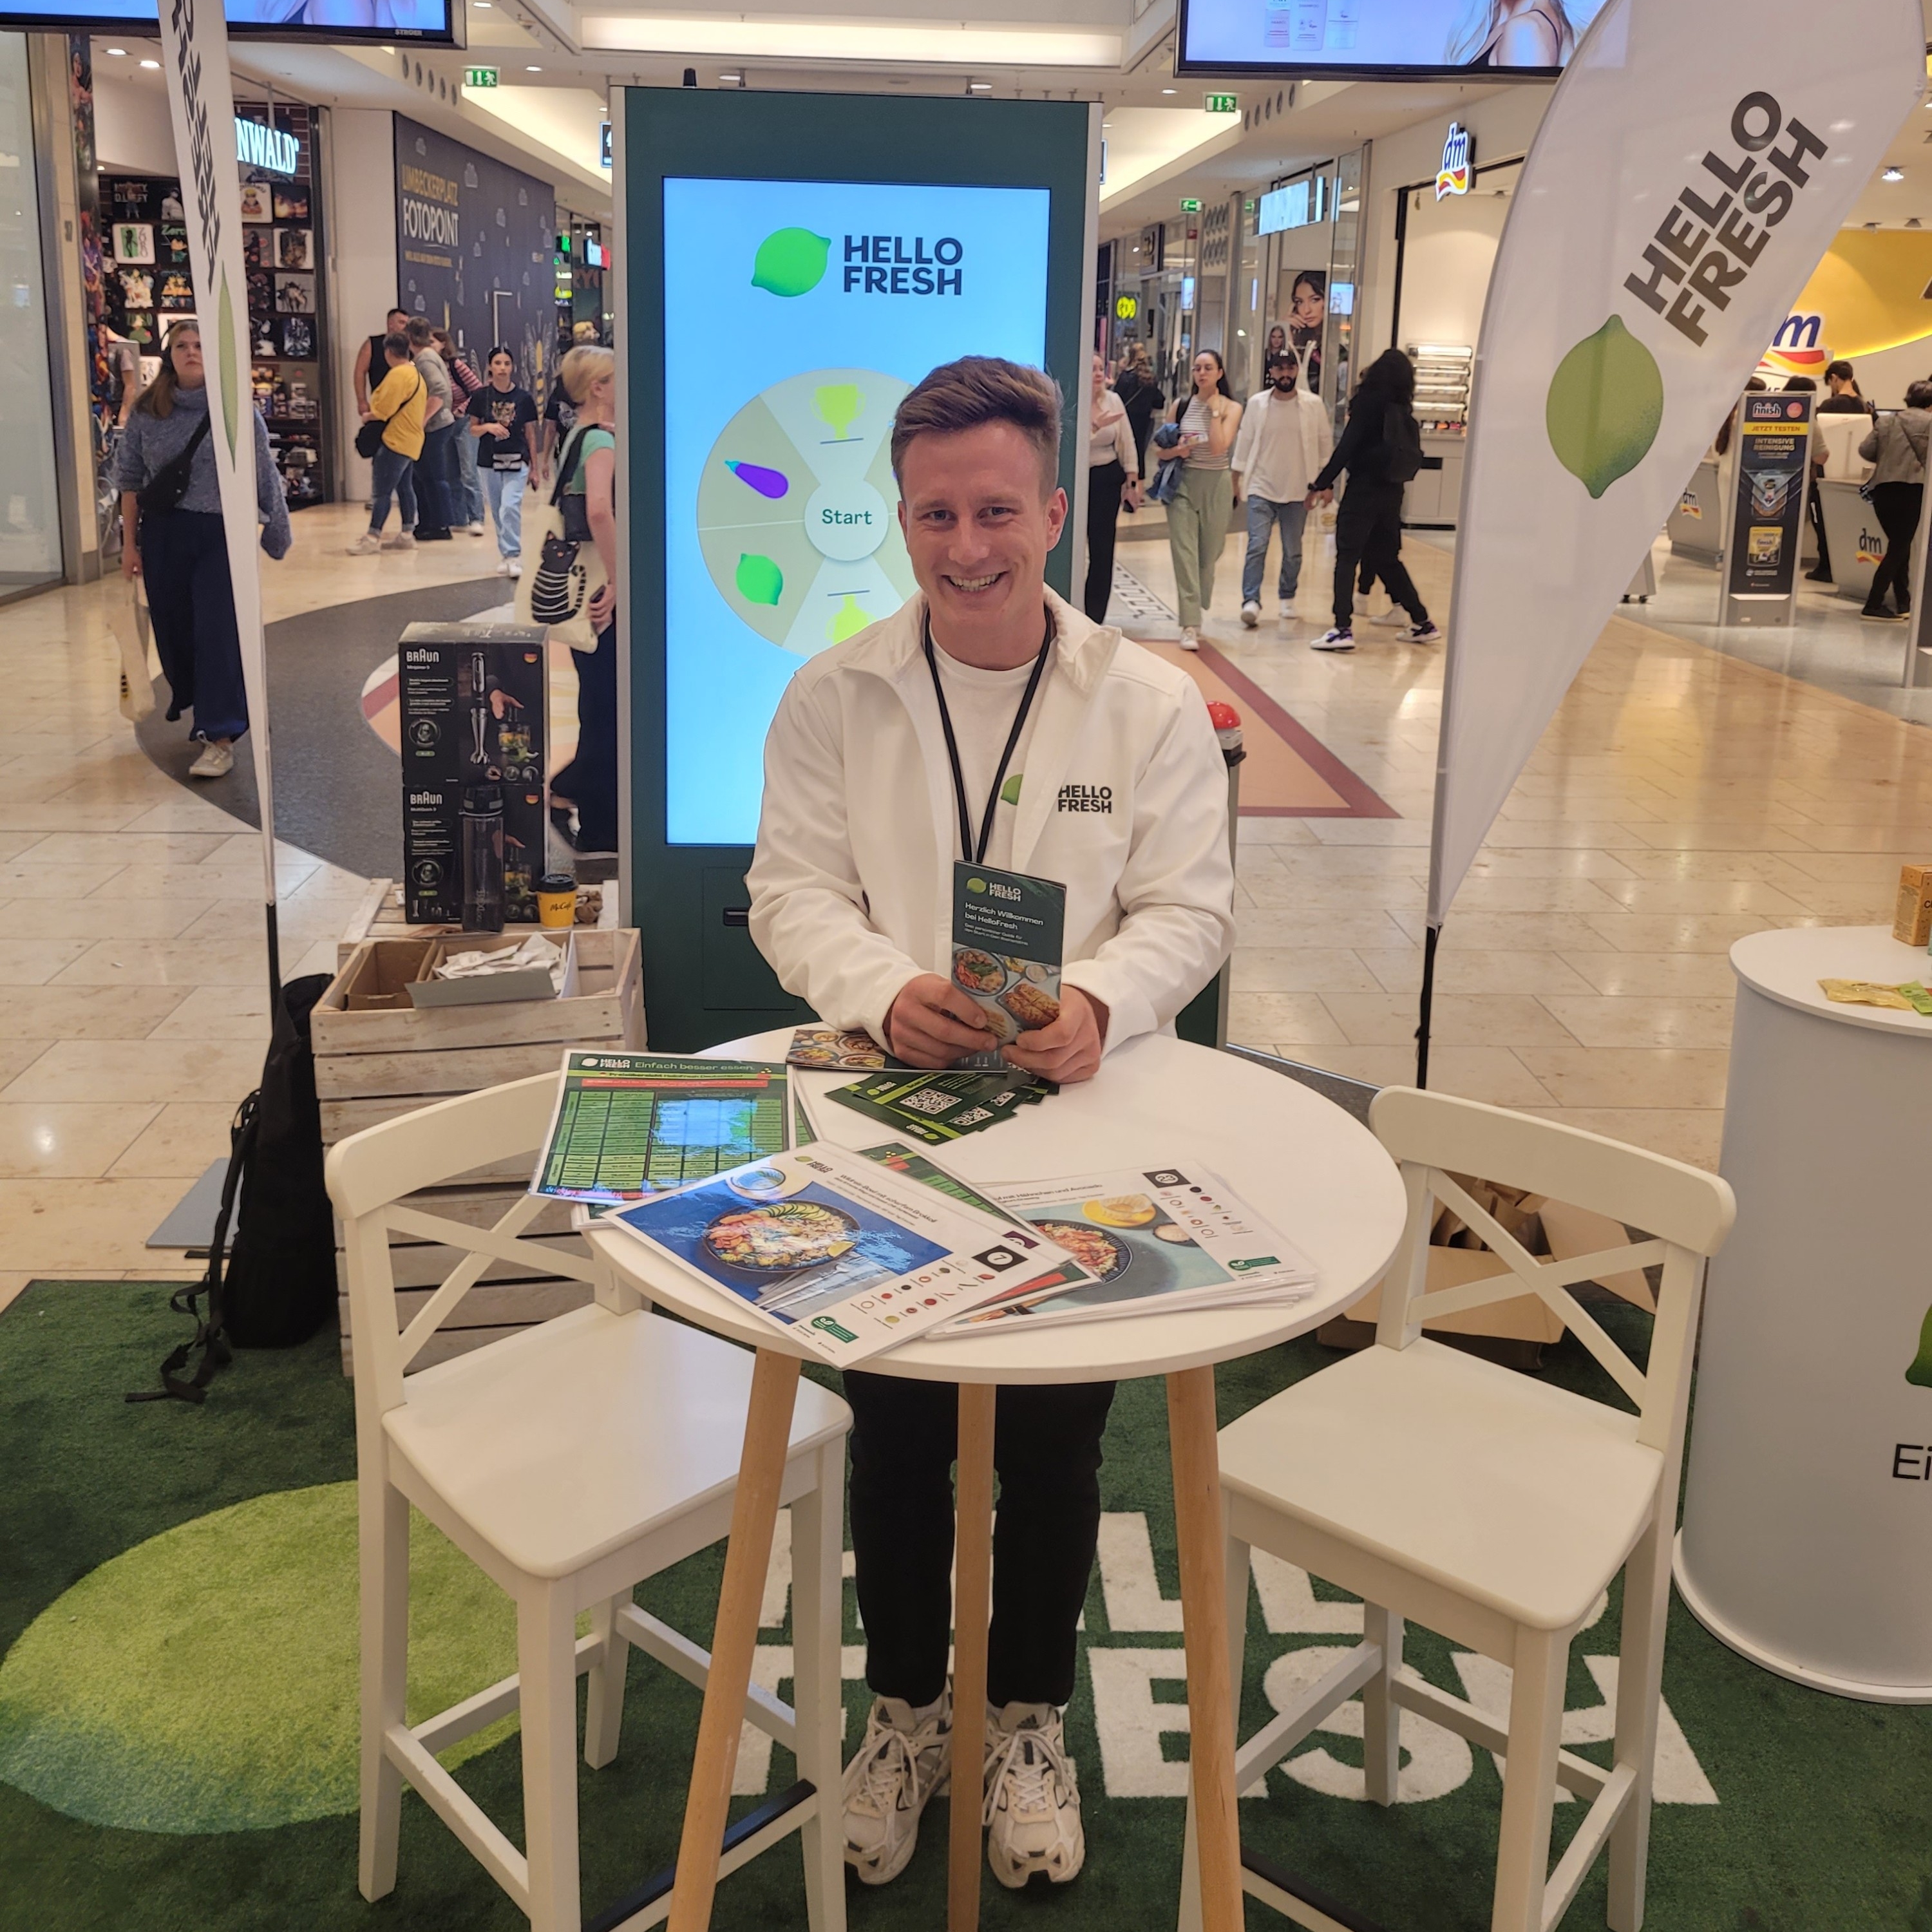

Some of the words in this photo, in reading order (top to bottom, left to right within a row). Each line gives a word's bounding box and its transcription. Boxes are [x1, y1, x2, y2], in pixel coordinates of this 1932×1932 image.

[1444, 128, 1466, 171] dm
[1623, 91, 1781, 314] HELLO
[403, 197, 459, 247] FOTOPOINT
[1664, 117, 1828, 348] FRESH
[844, 234, 963, 265] HELLO
[844, 265, 962, 296] FRESH
[1772, 315, 1821, 348] m
[1754, 403, 1781, 415] finish
[1682, 488, 1698, 506] dm
[822, 509, 873, 525] Start
[1859, 528, 1882, 554] dm
[406, 648, 439, 663] BRAUN
[410, 791, 442, 805] BRAUN
[1058, 784, 1112, 800] HELLO
[1058, 799, 1112, 814] FRESH
[989, 882, 1021, 895] HELLO
[989, 889, 1021, 902] FRESH
[965, 902, 996, 915] Herzlich
[997, 909, 1044, 926] Willkommen
[965, 911, 977, 921] bei
[978, 915, 1018, 930] HelloFresh
